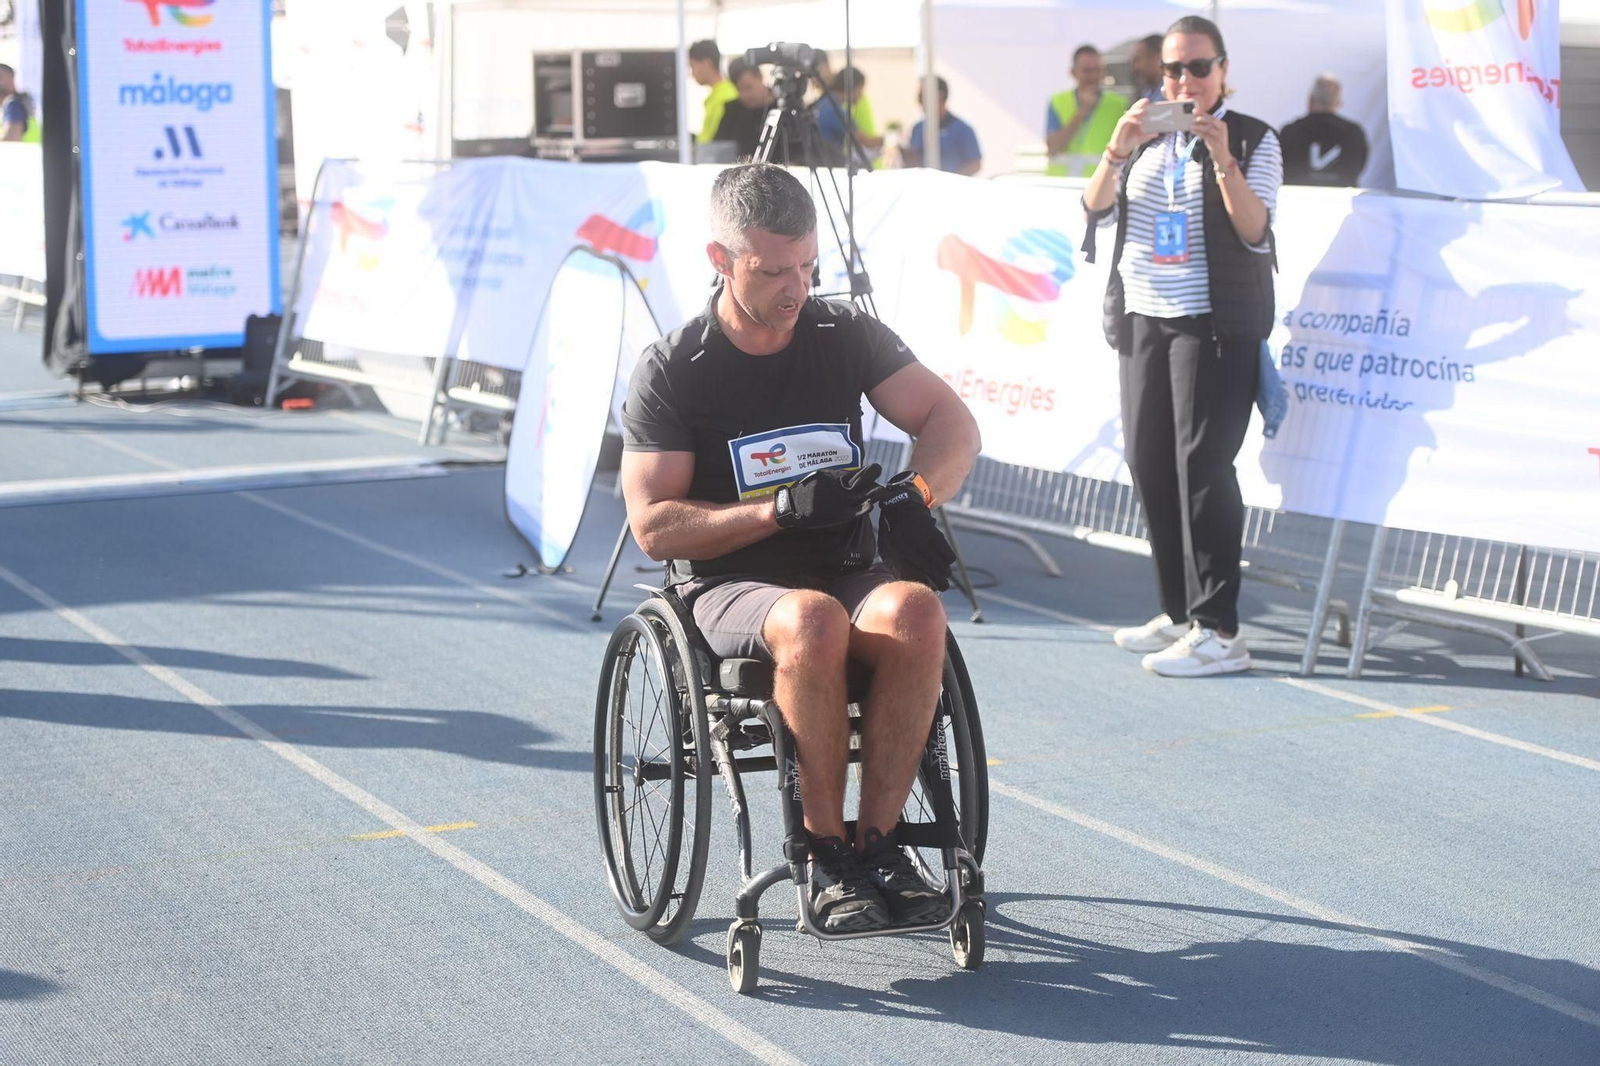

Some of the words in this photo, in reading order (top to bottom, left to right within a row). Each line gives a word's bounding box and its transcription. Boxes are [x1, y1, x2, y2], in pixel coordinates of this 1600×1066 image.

[1299, 309, 1411, 336] compañía
[1313, 350, 1354, 374] que
[1359, 351, 1476, 382] patrocina
[807, 450, 838, 459] MARATÓN
[807, 457, 833, 466] MÁLAGA
[754, 466, 792, 478] TotalEnergies
[933, 721, 950, 780] panthera
